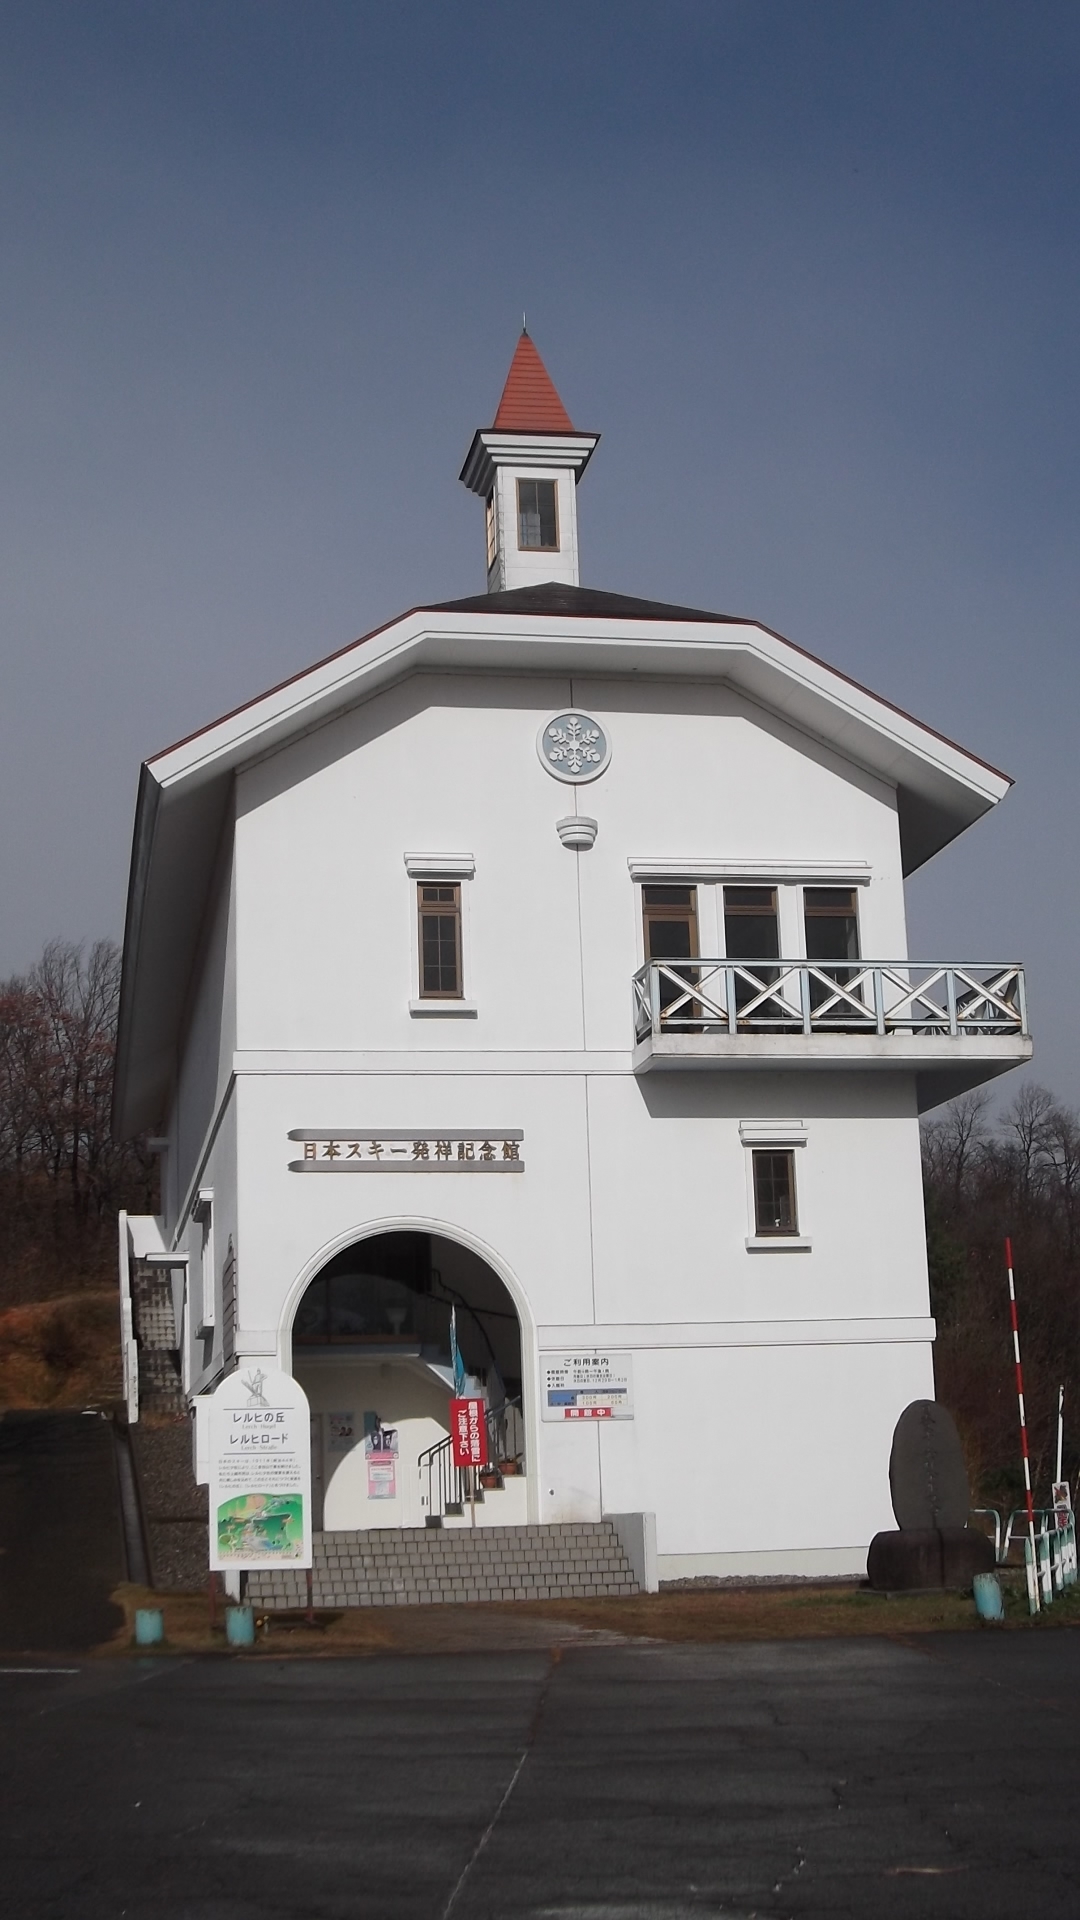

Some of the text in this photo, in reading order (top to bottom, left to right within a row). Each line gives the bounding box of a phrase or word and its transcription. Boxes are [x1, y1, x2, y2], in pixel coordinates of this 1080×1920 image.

[303, 1140, 521, 1162] 日本スキー発祥記念館
[563, 1358, 609, 1367] ご利用案内
[233, 1412, 285, 1423] レルヒの丘
[457, 1409, 470, 1456] ご注意下さい
[230, 1433, 288, 1444] レルヒロード
